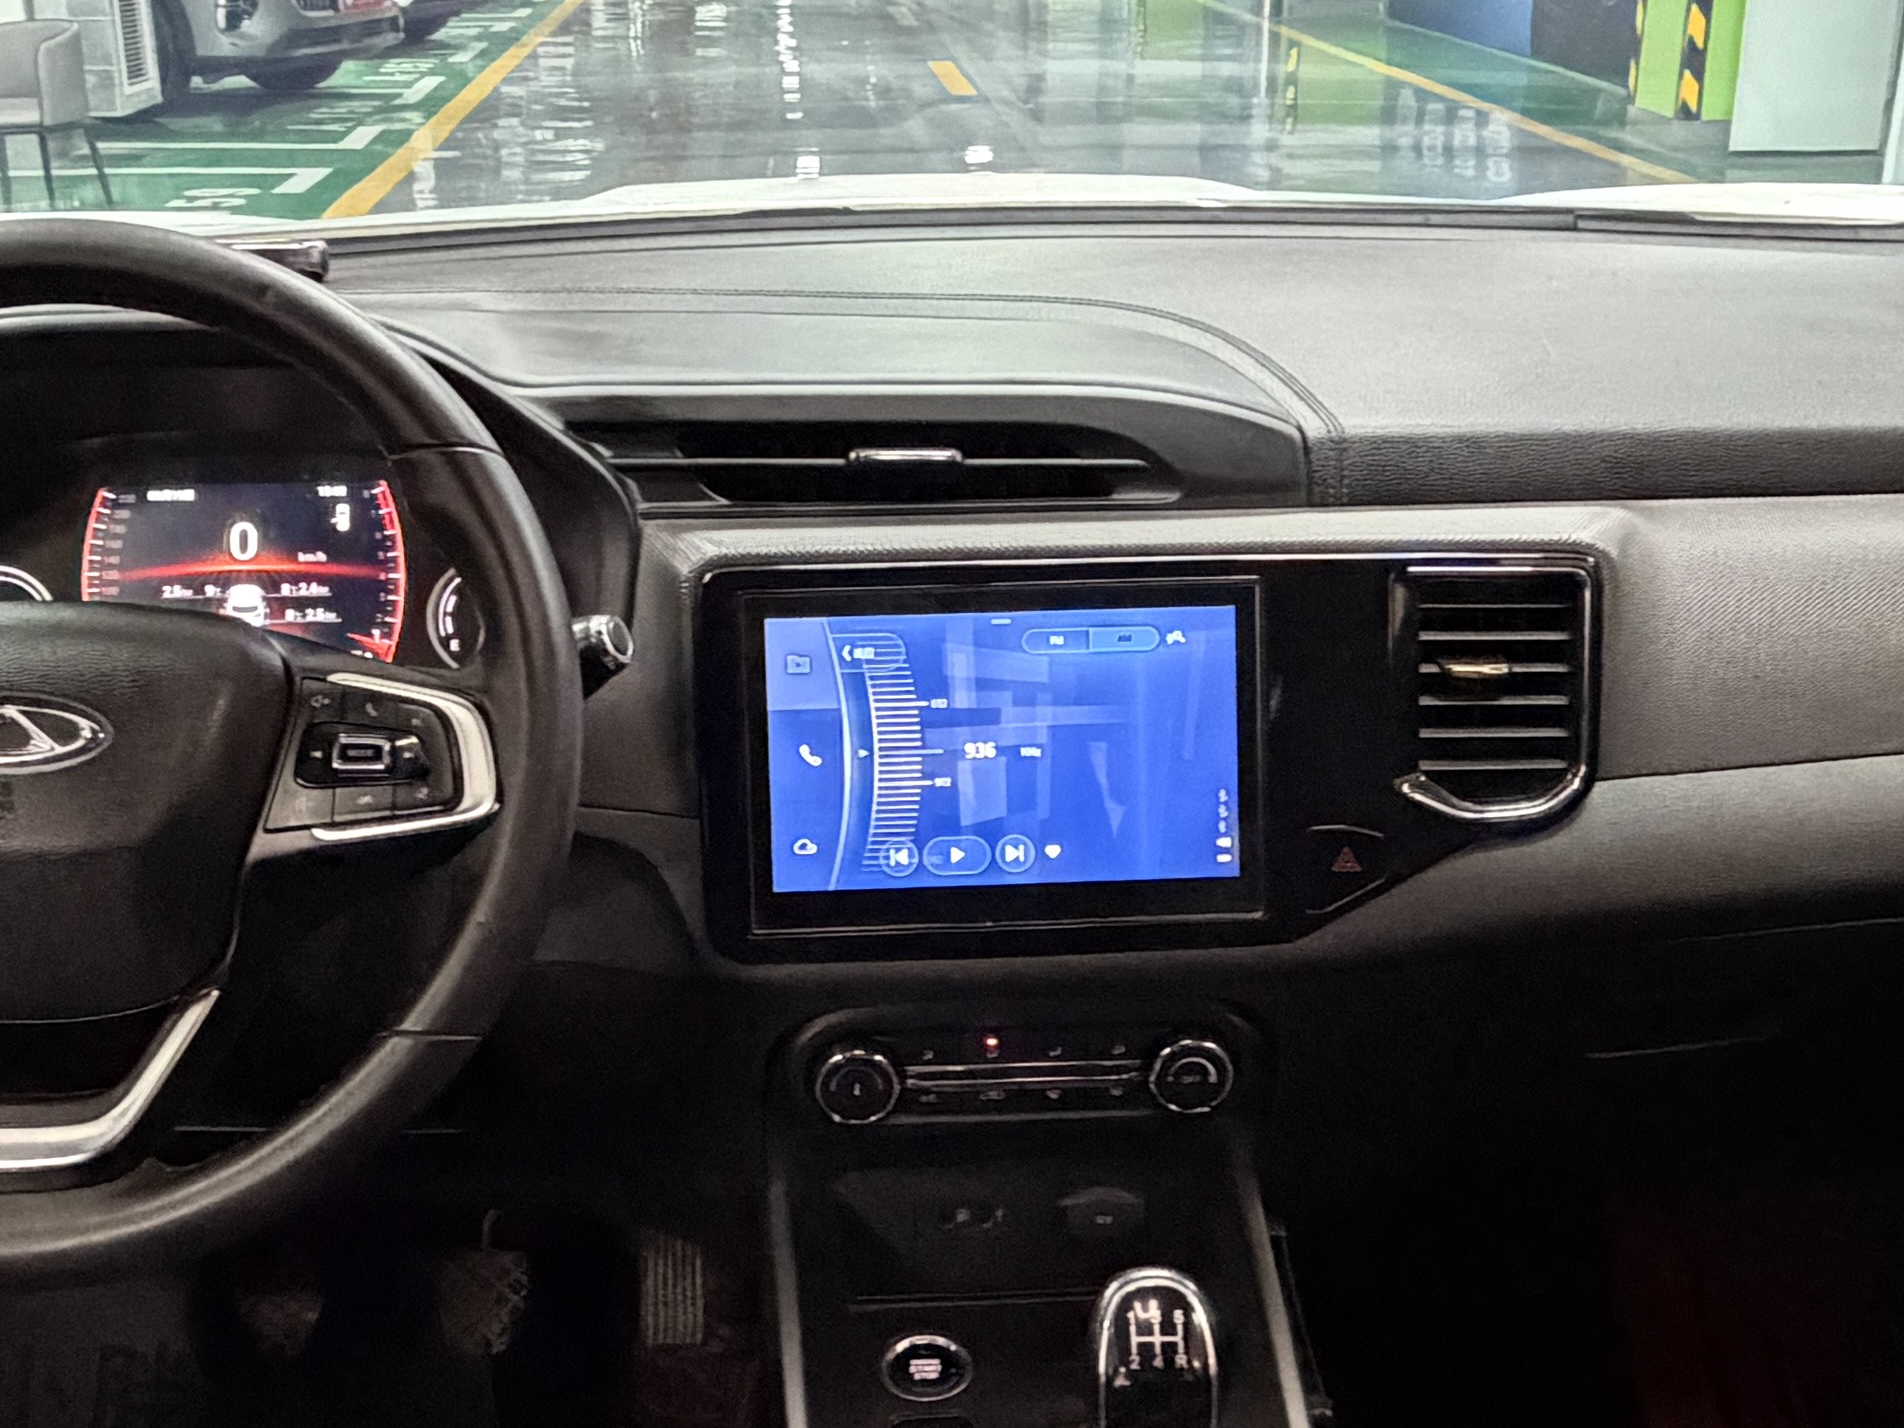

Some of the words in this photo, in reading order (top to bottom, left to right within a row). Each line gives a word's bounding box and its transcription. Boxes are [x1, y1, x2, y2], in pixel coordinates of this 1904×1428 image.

[227, 520, 259, 562] 0
[963, 741, 997, 760] 936
[1173, 1309, 1185, 1324] 5
[1129, 1354, 1141, 1370] 2
[1175, 1354, 1189, 1369] R
